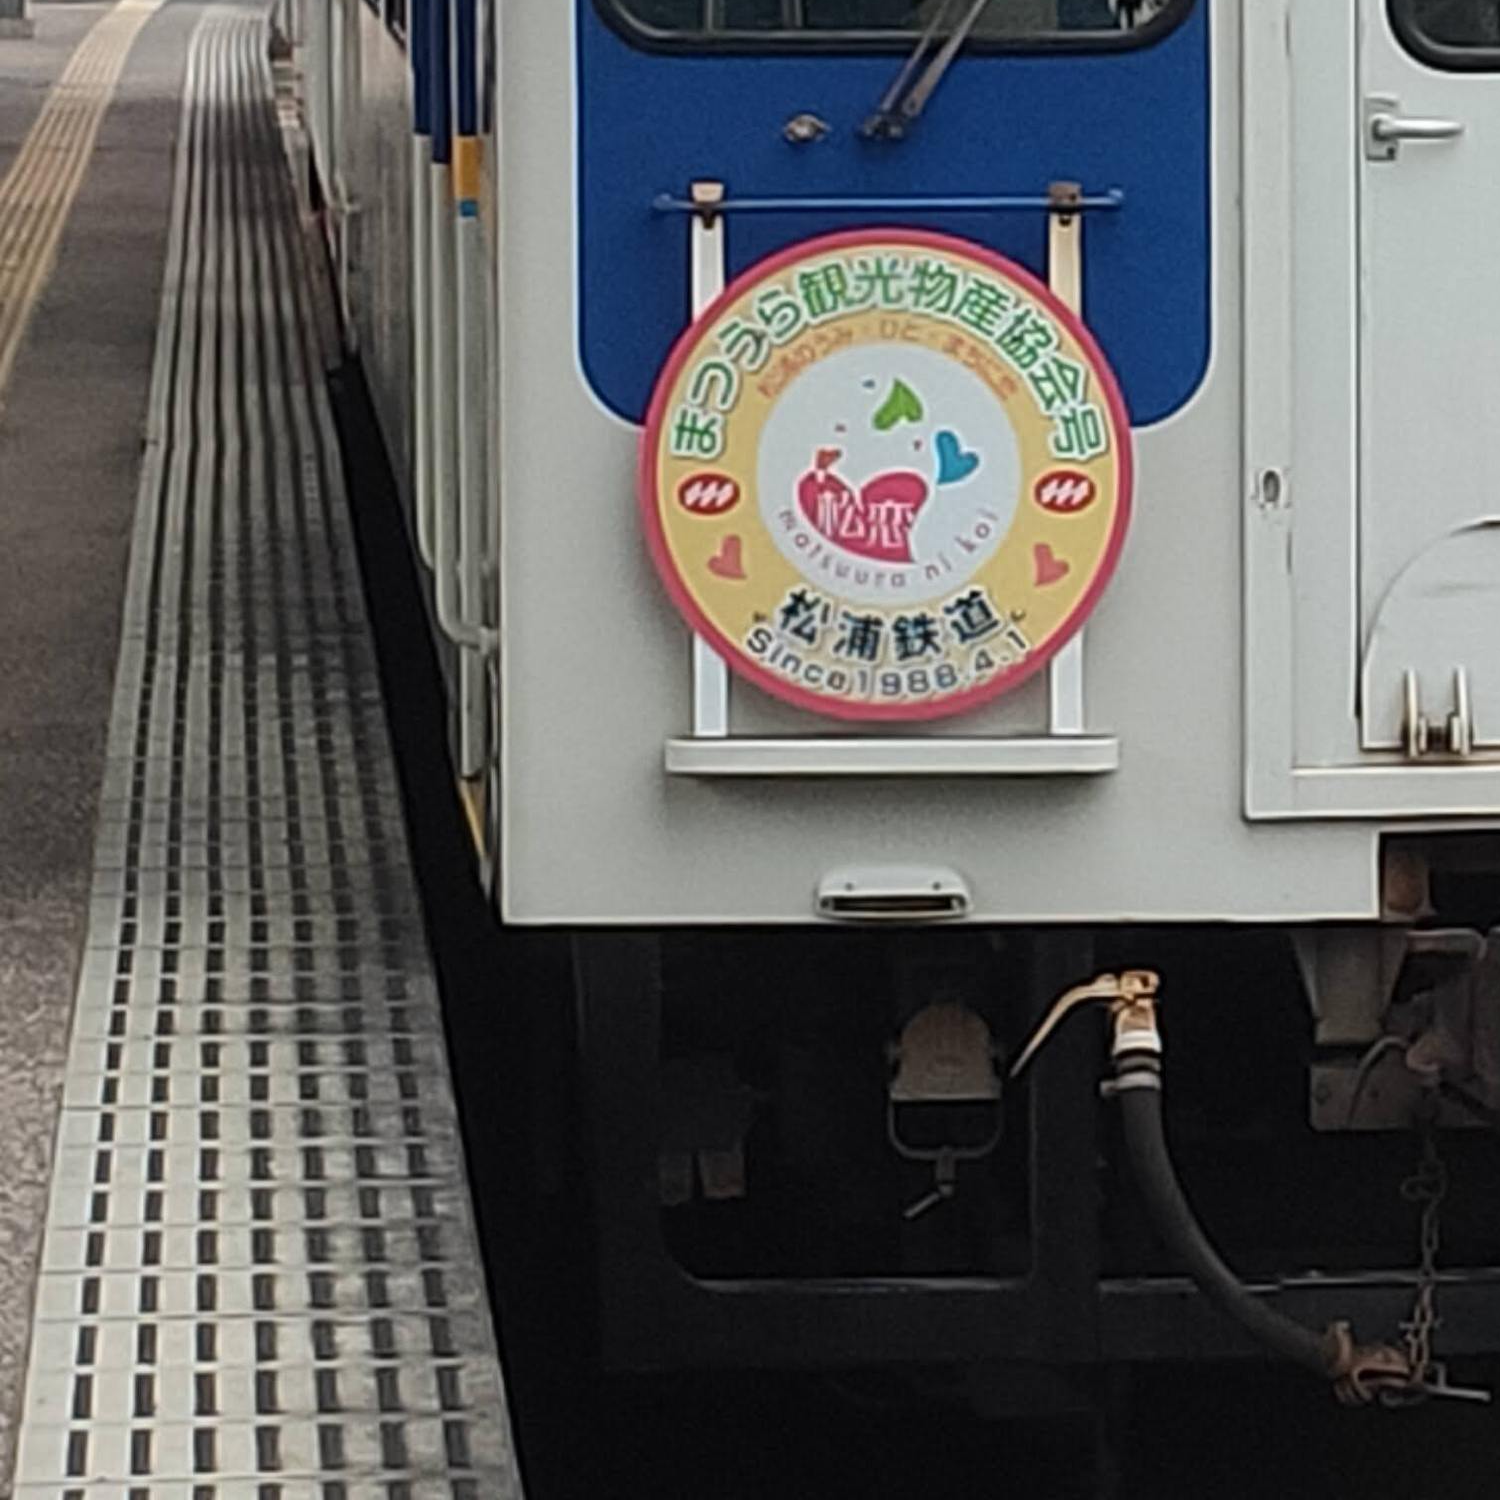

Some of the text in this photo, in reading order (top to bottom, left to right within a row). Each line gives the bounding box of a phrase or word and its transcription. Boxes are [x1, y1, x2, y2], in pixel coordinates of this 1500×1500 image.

[673, 257, 1106, 459] まつうら観光物産協会号
[780, 589, 999, 660] 松浦鉄道
